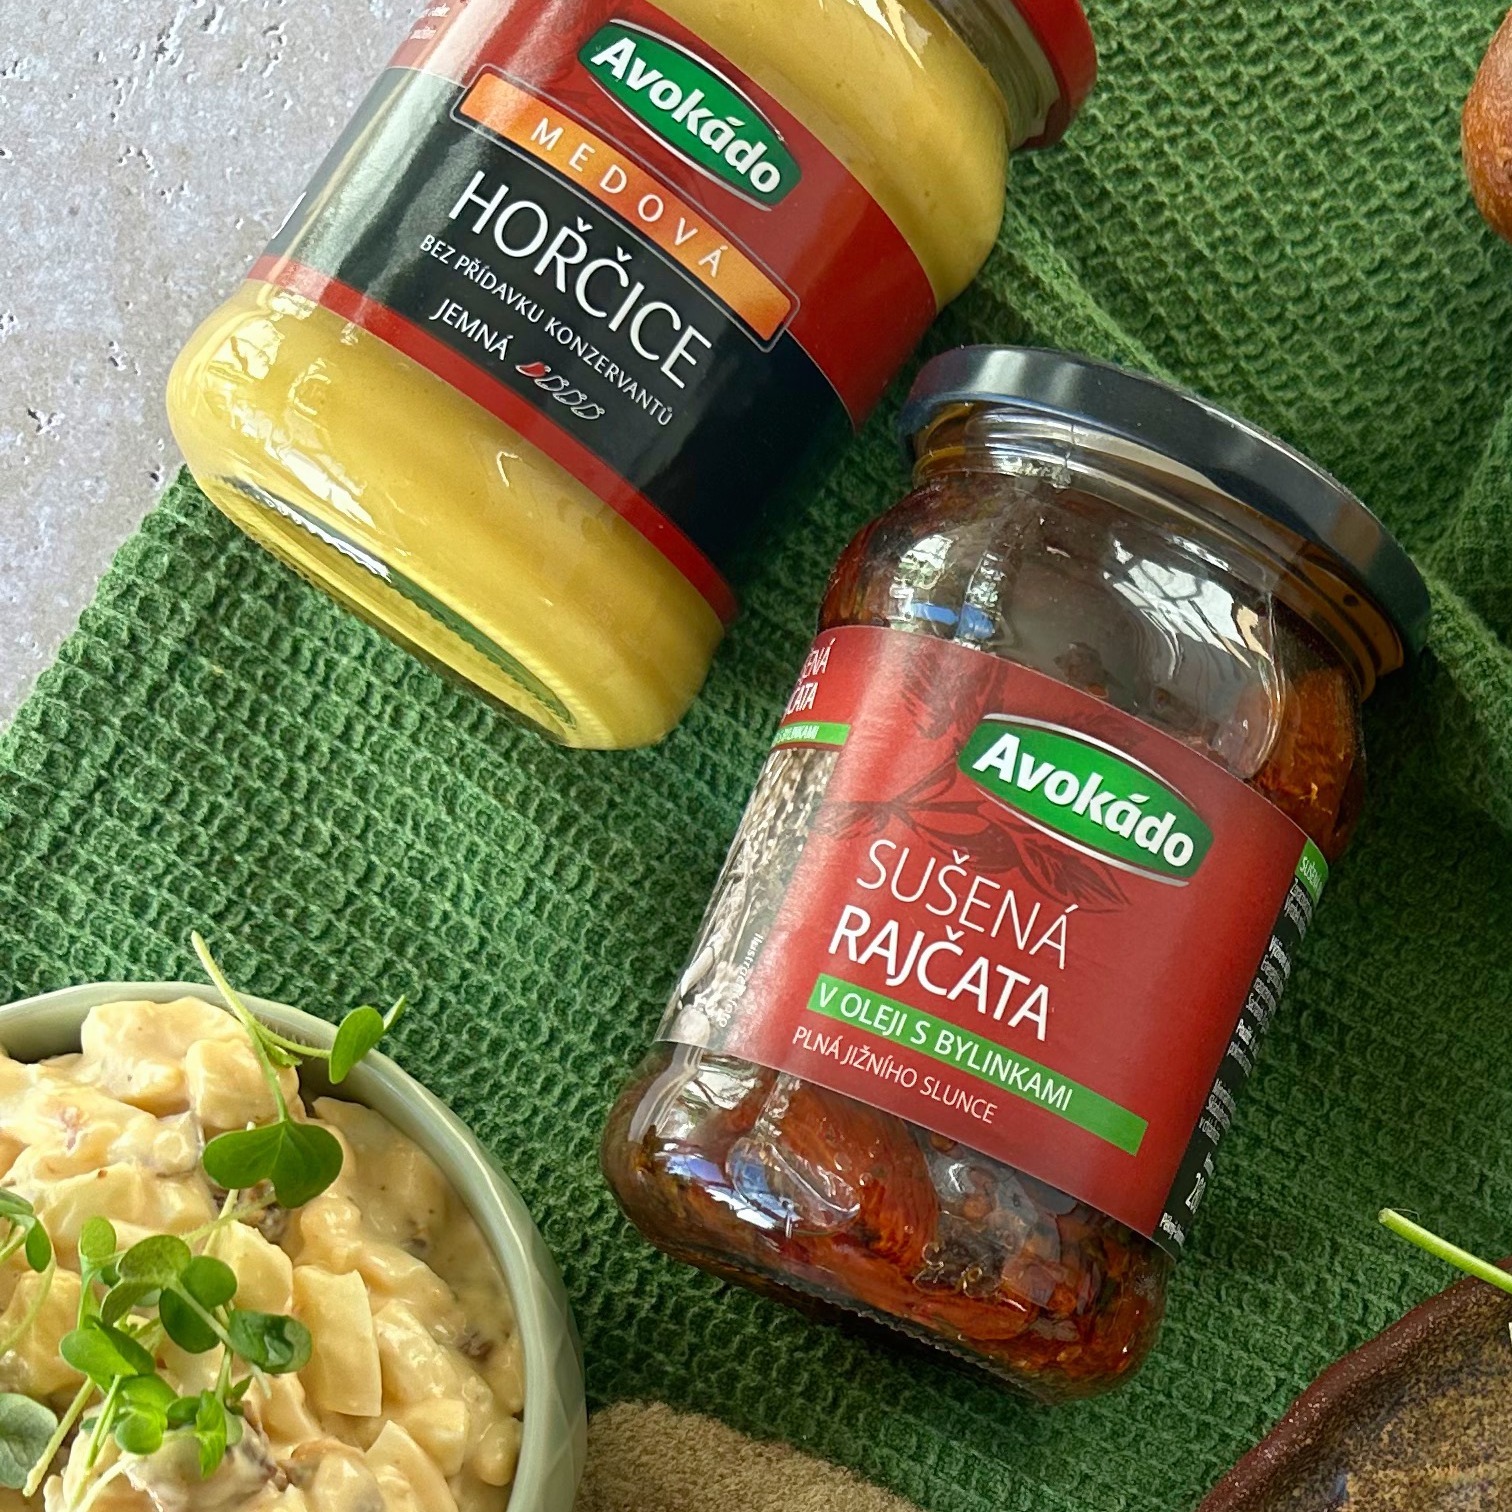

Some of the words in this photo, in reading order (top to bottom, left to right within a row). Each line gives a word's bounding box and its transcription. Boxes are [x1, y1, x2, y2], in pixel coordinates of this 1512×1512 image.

[591, 36, 782, 195] Avokádo
[530, 116, 729, 279] MEDOVÁ
[419, 234, 456, 264] BEZ
[454, 254, 545, 323] PŘÍDAVKU
[544, 317, 673, 426] KONZERVANTŮ
[429, 299, 514, 361] JEMNÁ
[449, 169, 712, 389] HOŘČICE
[972, 733, 1194, 868] Avokádo
[856, 838, 1079, 970] SUŠENÁ
[827, 904, 1049, 1042] RAJČATA
[792, 1026, 842, 1060] PLNÁ
[840, 1044, 918, 1088] JIŽNÍHO
[920, 1076, 998, 1124] SLUNCE
[819, 982, 838, 1008] V
[839, 992, 908, 1036] OLEJI
[910, 1020, 931, 1045] S
[933, 1029, 1073, 1111] BYLINKAMI
